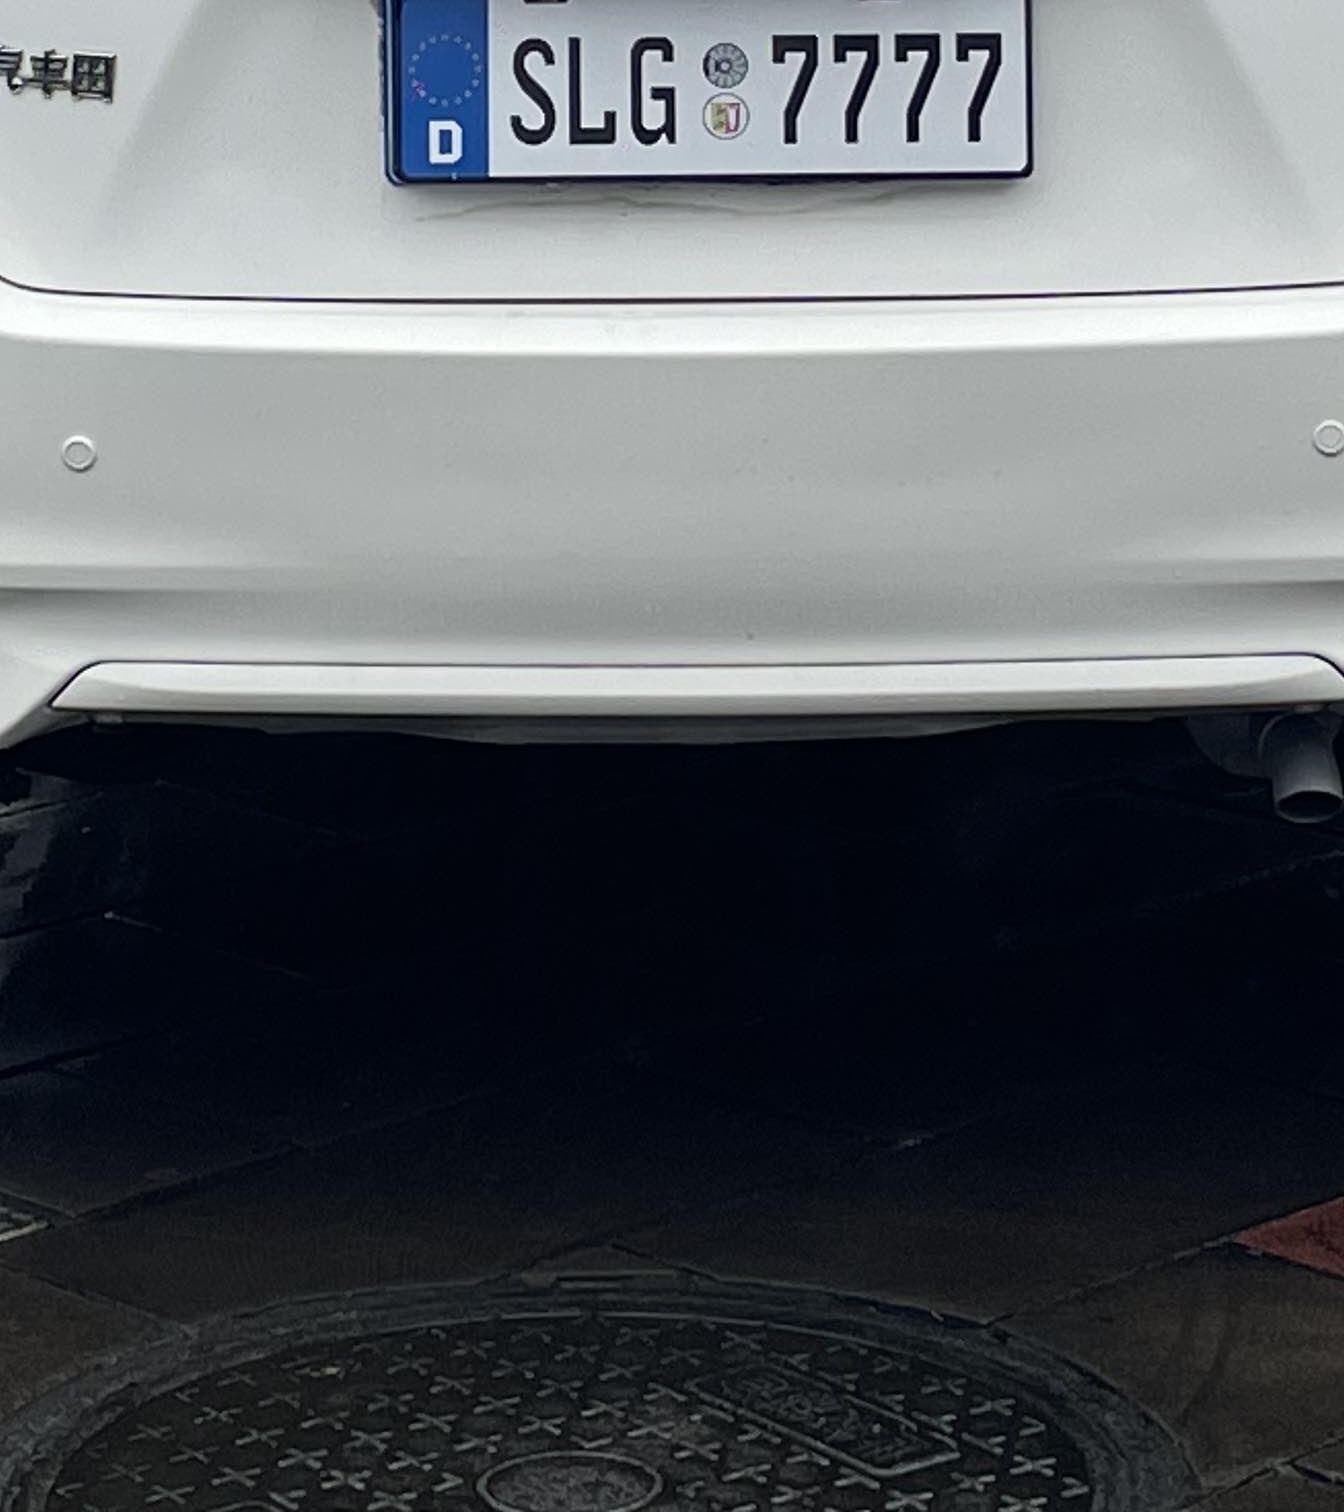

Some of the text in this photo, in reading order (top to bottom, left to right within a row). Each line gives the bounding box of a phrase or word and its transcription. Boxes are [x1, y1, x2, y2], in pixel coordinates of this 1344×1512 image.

[510, 32, 1003, 146] SLG 7777
[428, 119, 464, 165] D
